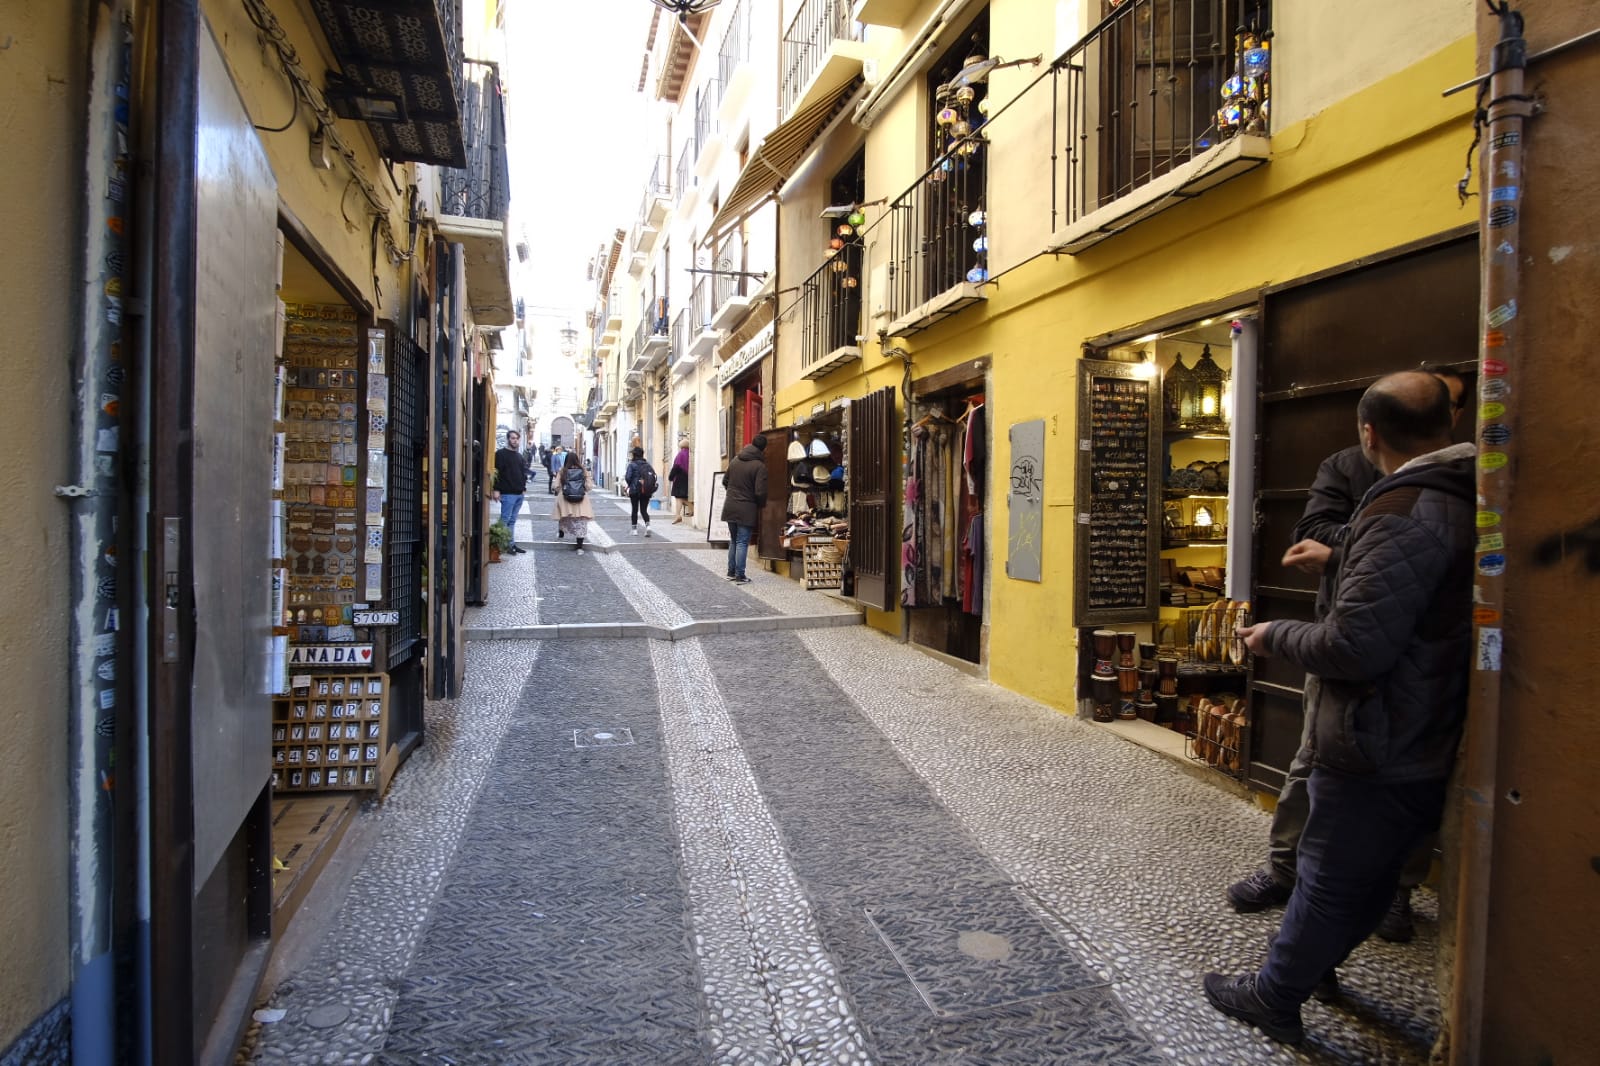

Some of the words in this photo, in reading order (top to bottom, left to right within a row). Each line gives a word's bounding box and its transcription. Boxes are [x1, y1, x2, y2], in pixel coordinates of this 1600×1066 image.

[353, 612, 399, 624] 57078
[290, 647, 357, 662] ANADA
[320, 683, 328, 694] F
[332, 683, 341, 693] G
[351, 683, 359, 694] H
[348, 704, 356, 715] P
[371, 703, 379, 714] Q
[293, 728, 301, 738] V
[309, 728, 318, 737] W
[331, 726, 340, 736] X
[348, 727, 356, 737] Y
[307, 750, 316, 760] 5
[329, 749, 337, 759] 6
[350, 749, 358, 759] 7
[368, 748, 376, 758] 8
